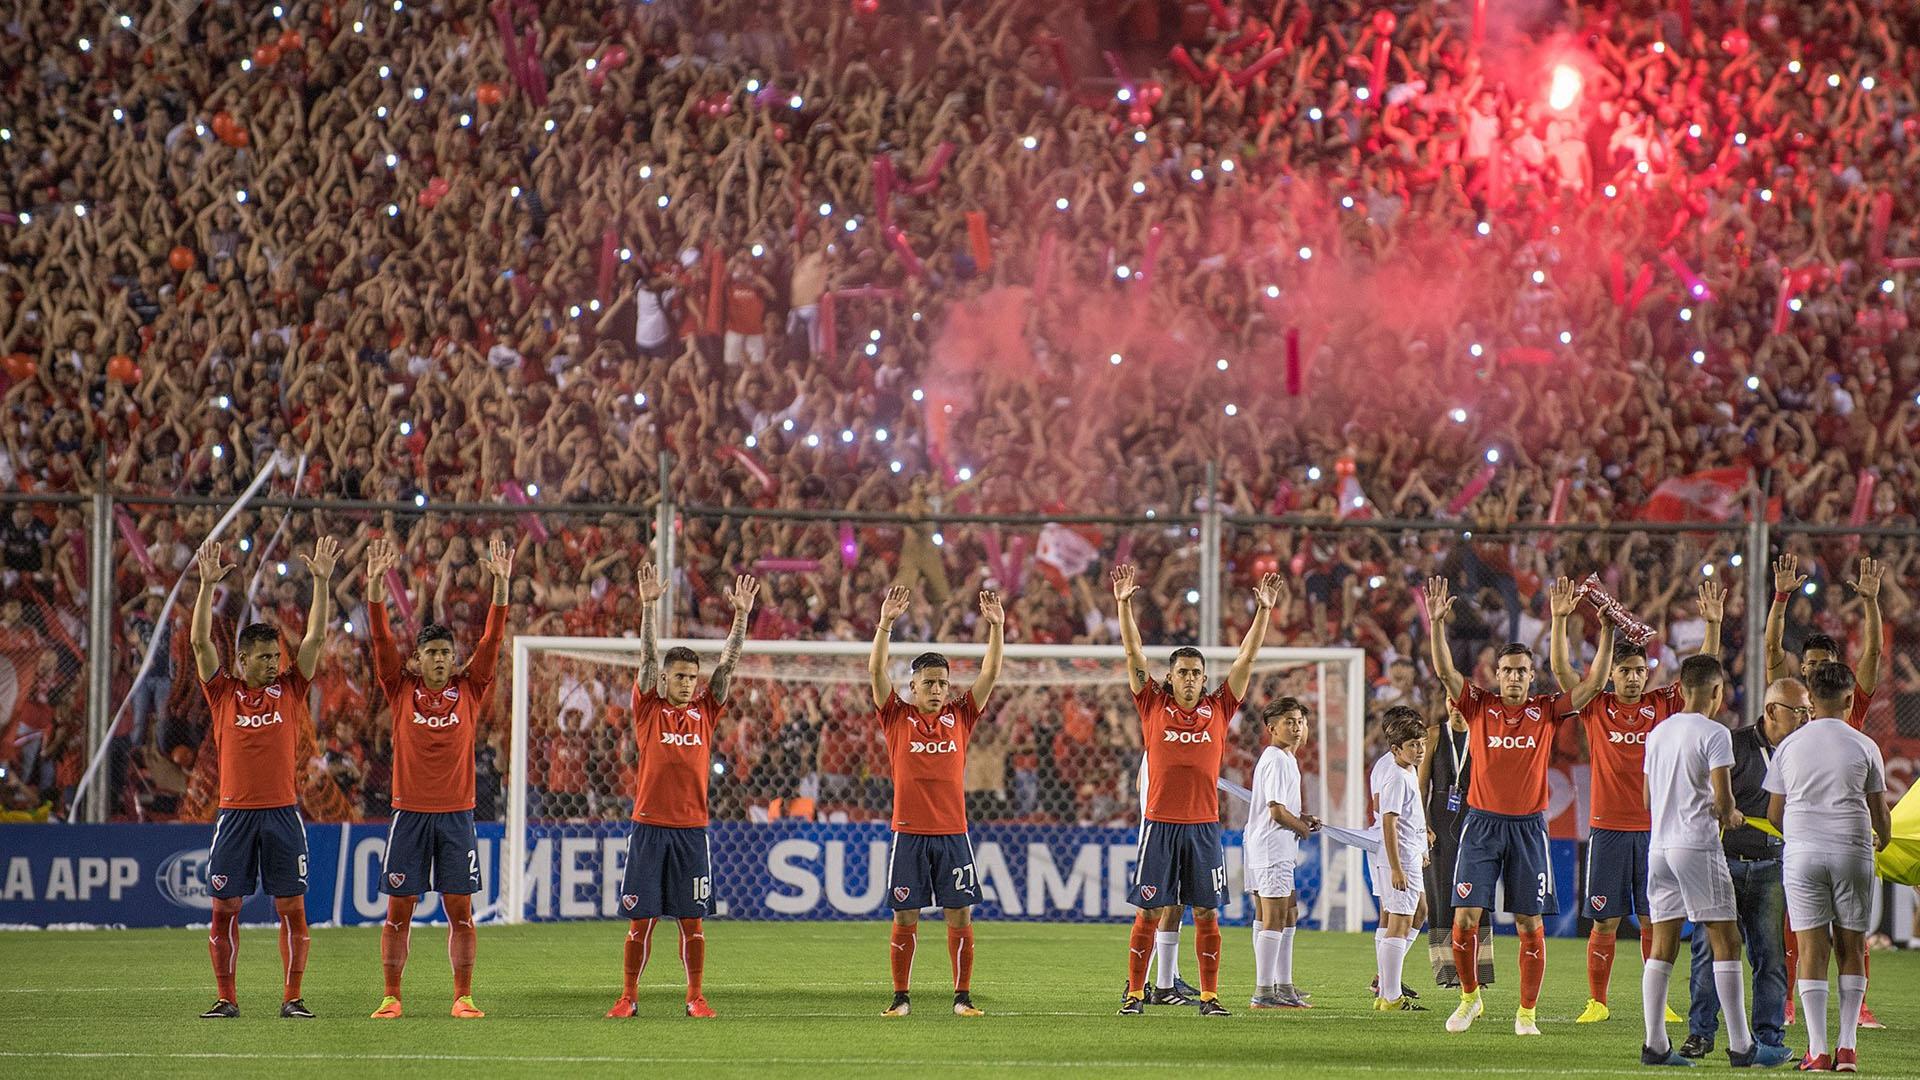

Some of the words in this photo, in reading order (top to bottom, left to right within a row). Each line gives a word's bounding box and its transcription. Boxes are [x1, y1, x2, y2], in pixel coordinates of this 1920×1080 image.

[251, 711, 283, 728] OCA
[427, 712, 460, 728] OCA
[674, 733, 702, 746] OCA
[1180, 730, 1212, 744] OCA
[1503, 735, 1536, 749] OCA
[1623, 732, 1649, 744] OC
[926, 740, 957, 754] OCA
[297, 854, 308, 877] 6
[467, 850, 479, 873] 2
[46, 857, 139, 900] APP
[952, 863, 974, 891] 27
[1537, 872, 1547, 897] 3
[693, 876, 709, 900] 16
